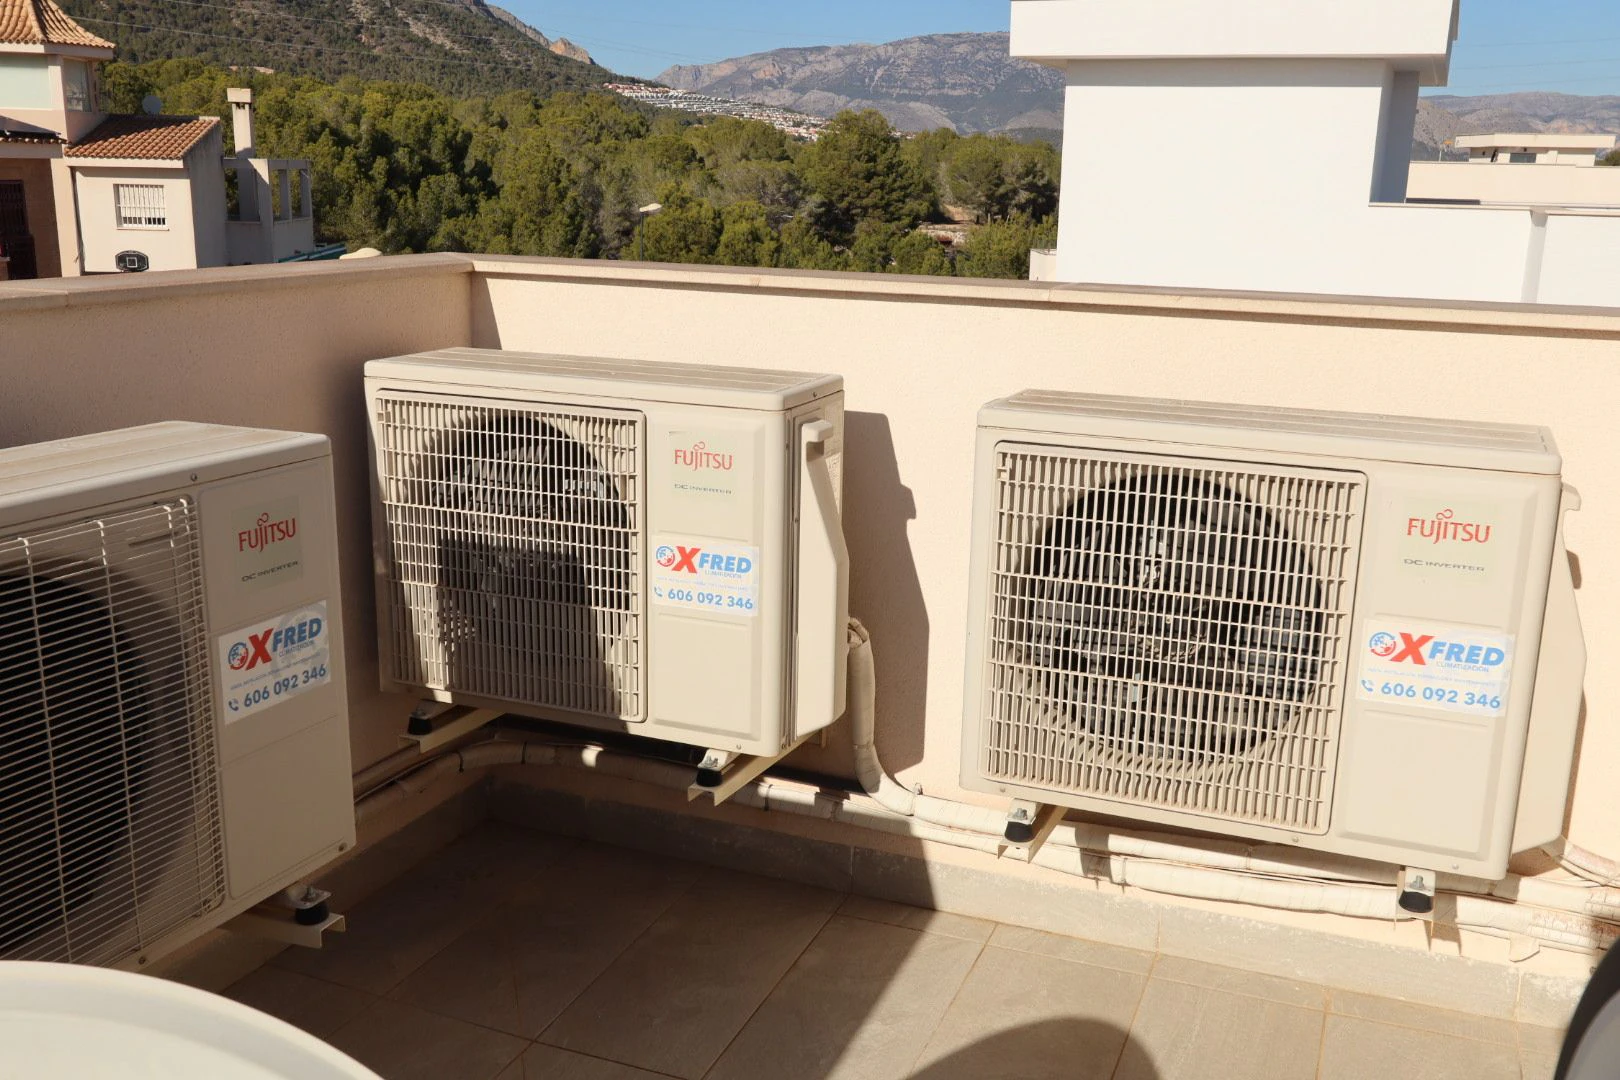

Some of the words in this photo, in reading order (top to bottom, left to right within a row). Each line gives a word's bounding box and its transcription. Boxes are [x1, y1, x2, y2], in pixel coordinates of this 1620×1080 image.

[674, 448, 733, 471] FUJITSU
[238, 517, 296, 552] FUJITSU
[1406, 517, 1491, 544] FUJITSU
[1403, 558, 1424, 566] DC
[1425, 561, 1485, 572] INVERTER
[668, 589, 693, 602] 606
[697, 592, 723, 606] 092
[727, 596, 753, 610] 346
[244, 686, 270, 707] 606
[273, 674, 298, 695] 092
[302, 663, 326, 684] 346
[1381, 682, 1416, 698] 606
[1422, 686, 1458, 703] 092
[1464, 691, 1501, 709] 346
